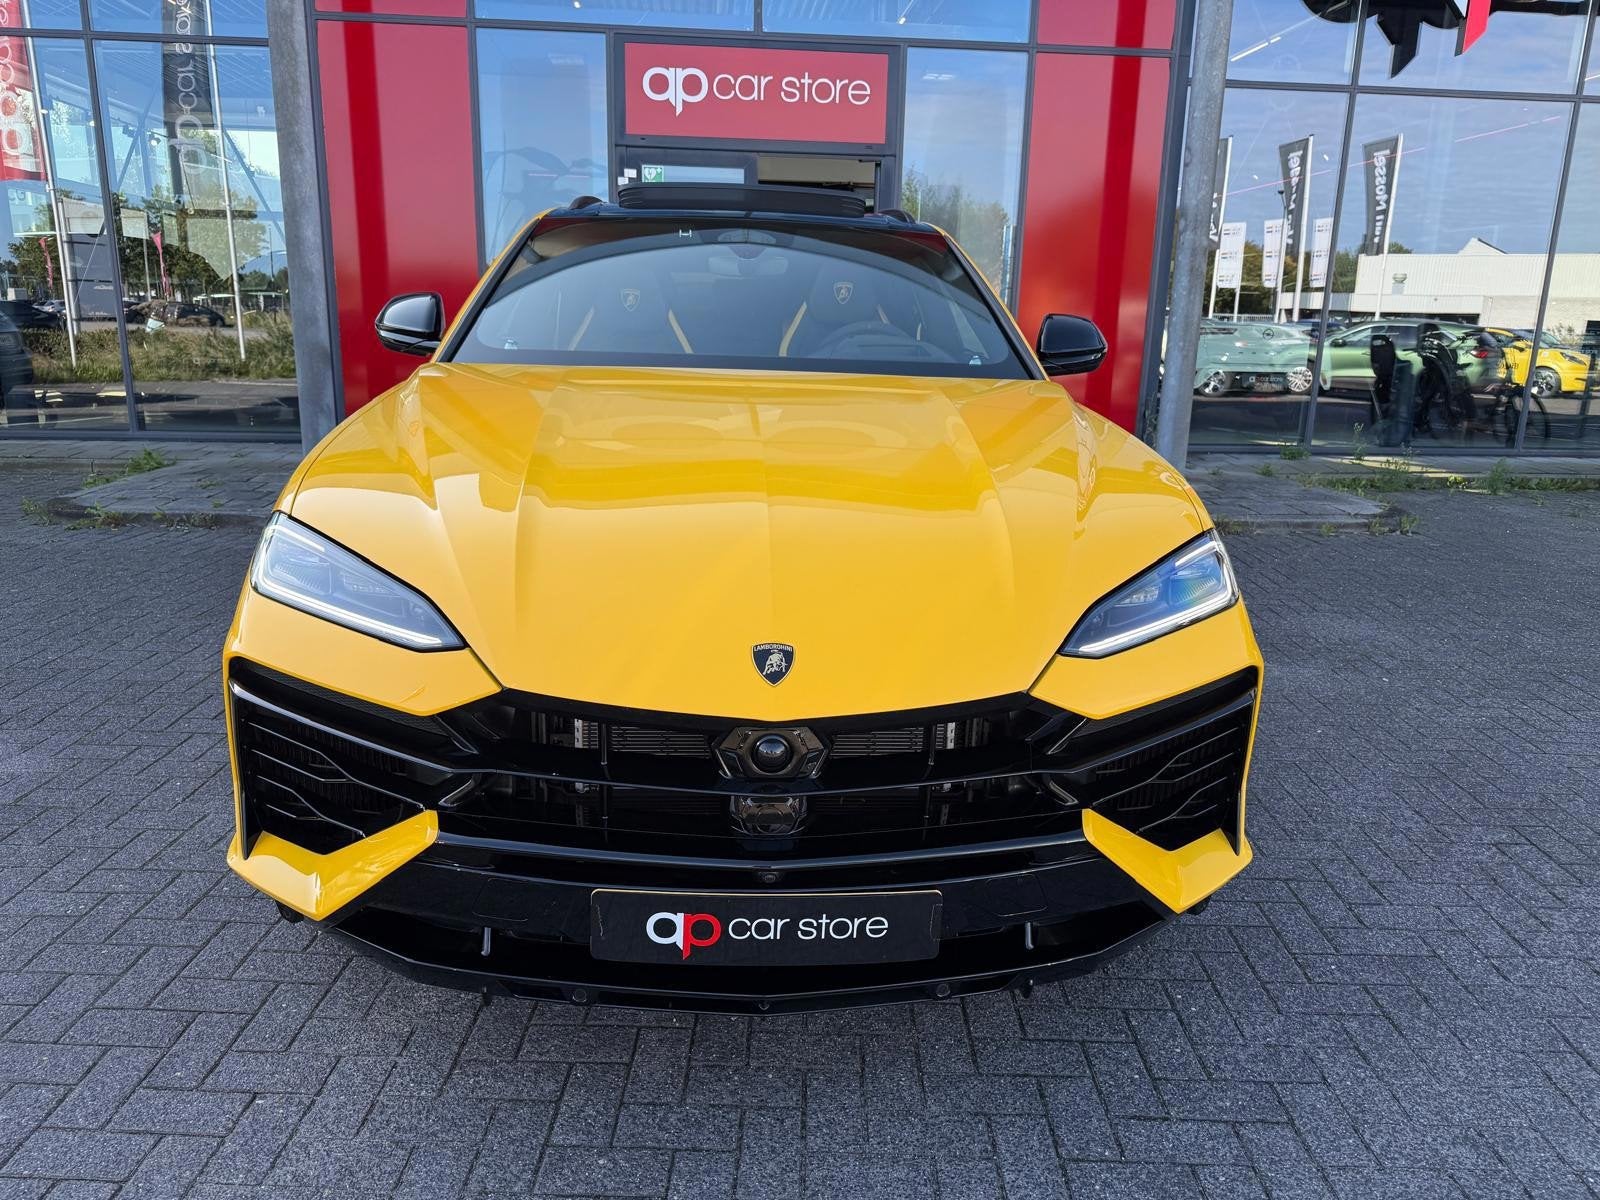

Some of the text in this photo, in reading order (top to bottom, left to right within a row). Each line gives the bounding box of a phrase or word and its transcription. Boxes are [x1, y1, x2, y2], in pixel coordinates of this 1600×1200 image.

[642, 66, 871, 117] ap car store
[646, 911, 889, 960] ap car store
